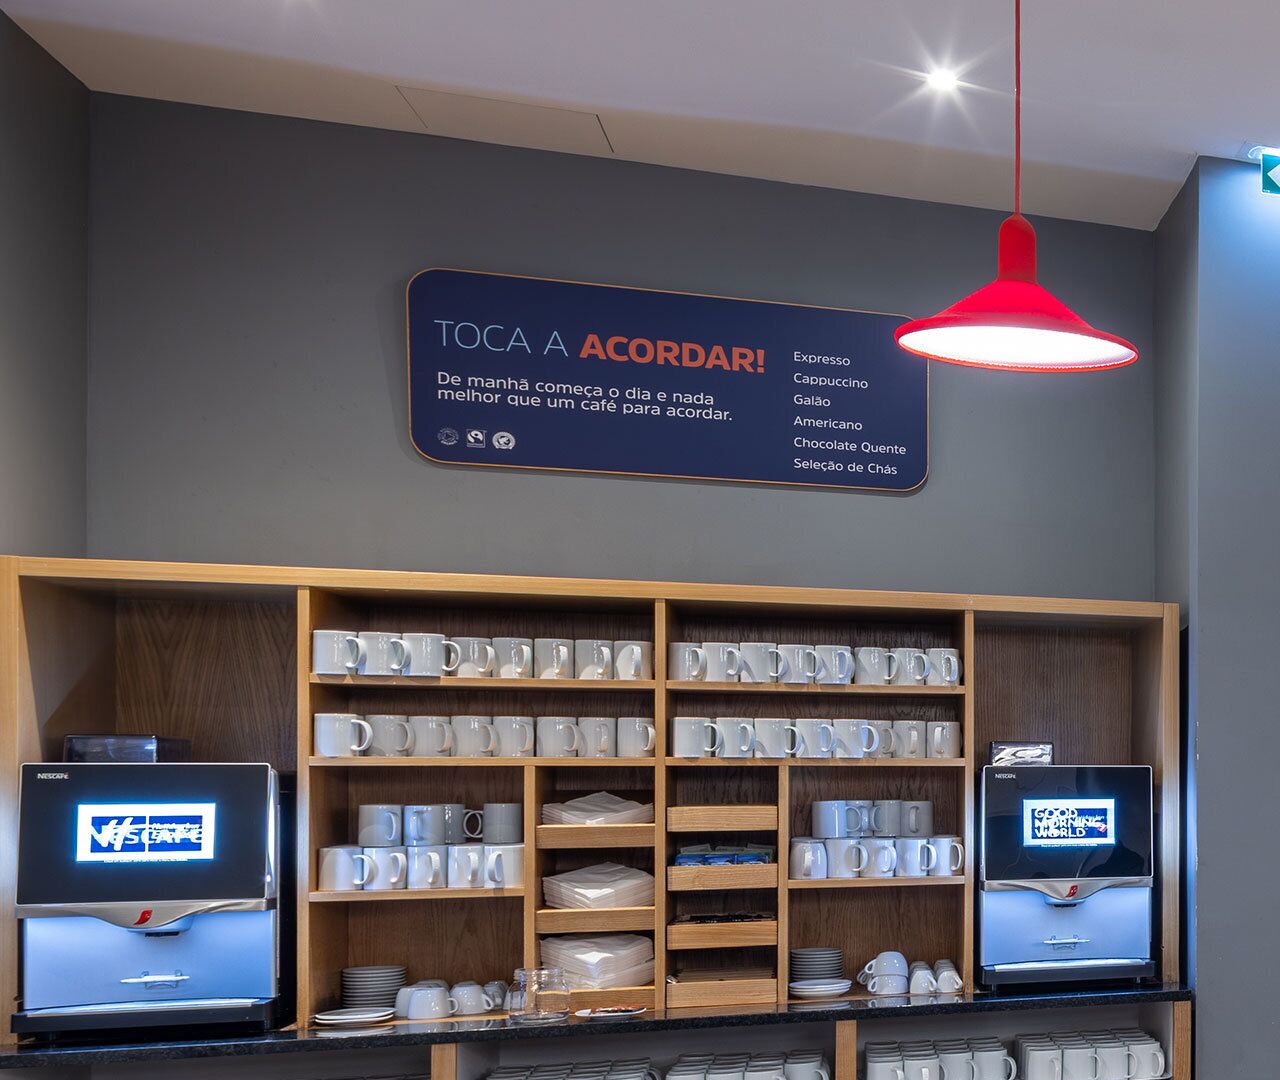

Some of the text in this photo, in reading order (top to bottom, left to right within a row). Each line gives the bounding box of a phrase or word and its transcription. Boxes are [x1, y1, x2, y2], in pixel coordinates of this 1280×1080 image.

[434, 320, 765, 373] TOCA A ACORDAR!
[793, 351, 851, 366] Expresso
[437, 372, 714, 405] De manhã começa o dia e nada
[793, 372, 869, 389] Cappuccino
[437, 389, 733, 421] melhor que um café para acordar.
[793, 394, 831, 407] Galão
[793, 416, 863, 431] Americano
[793, 437, 907, 455] Chocolate Quente
[793, 458, 898, 475] Seleção de Chás
[1034, 808, 1078, 818] GOOD
[1034, 827, 1086, 838] WORLD
